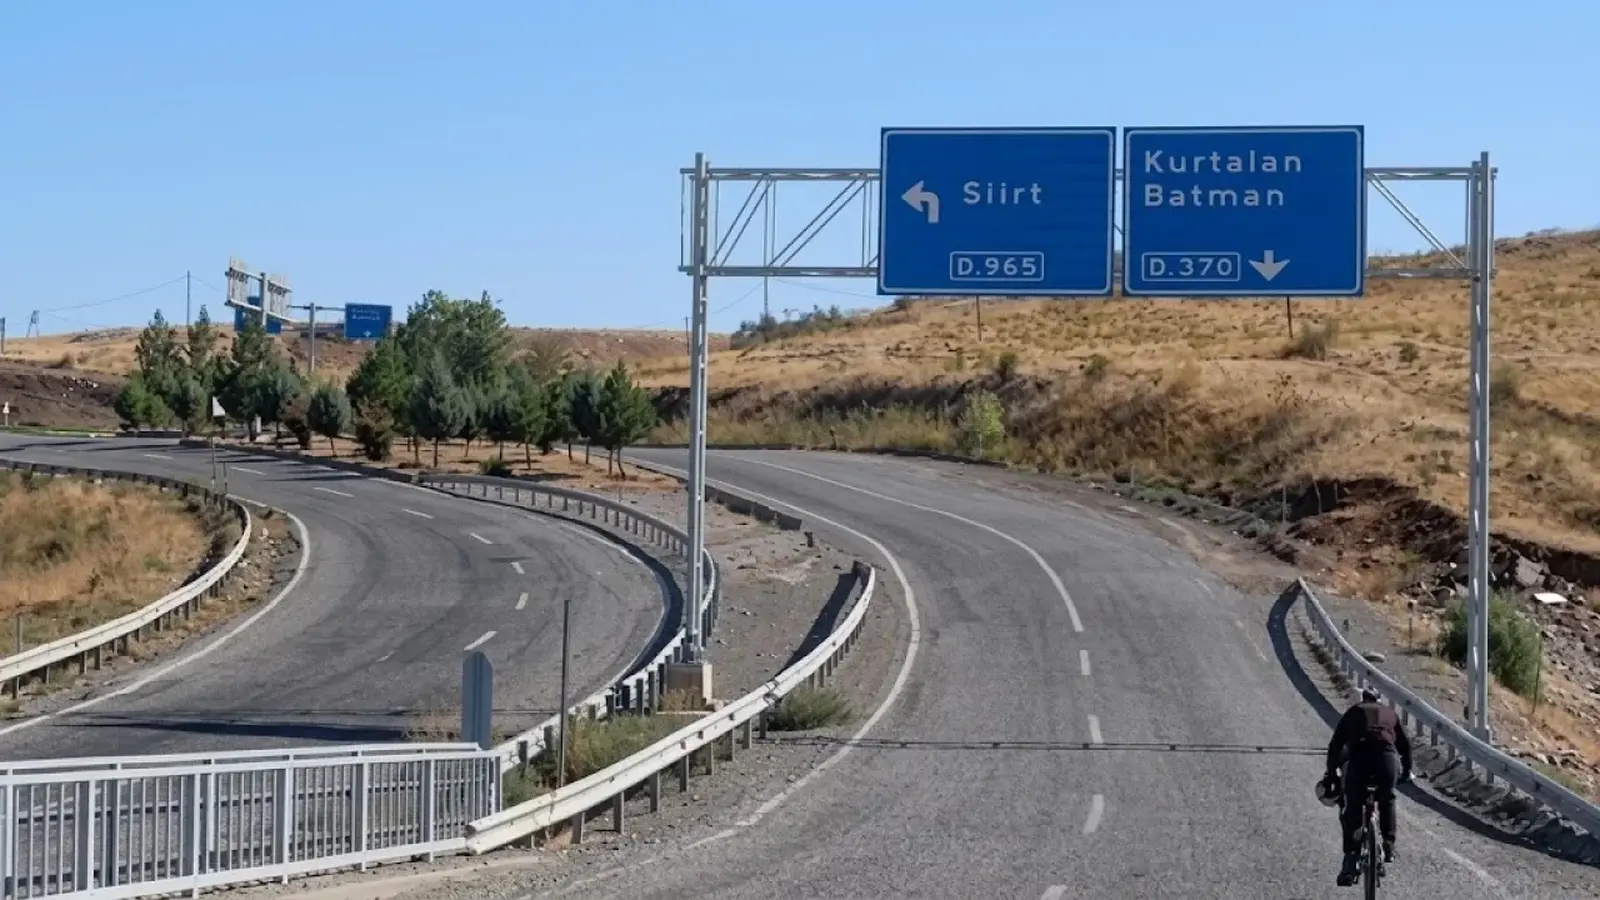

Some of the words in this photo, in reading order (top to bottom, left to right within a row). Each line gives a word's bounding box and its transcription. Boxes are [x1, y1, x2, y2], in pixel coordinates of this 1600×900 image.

[1144, 150, 1302, 173] Kurtalan
[962, 181, 1042, 205] Siirt
[1144, 183, 1285, 207] Batman
[956, 257, 1037, 277] D.965
[1149, 257, 1234, 277] D.370
